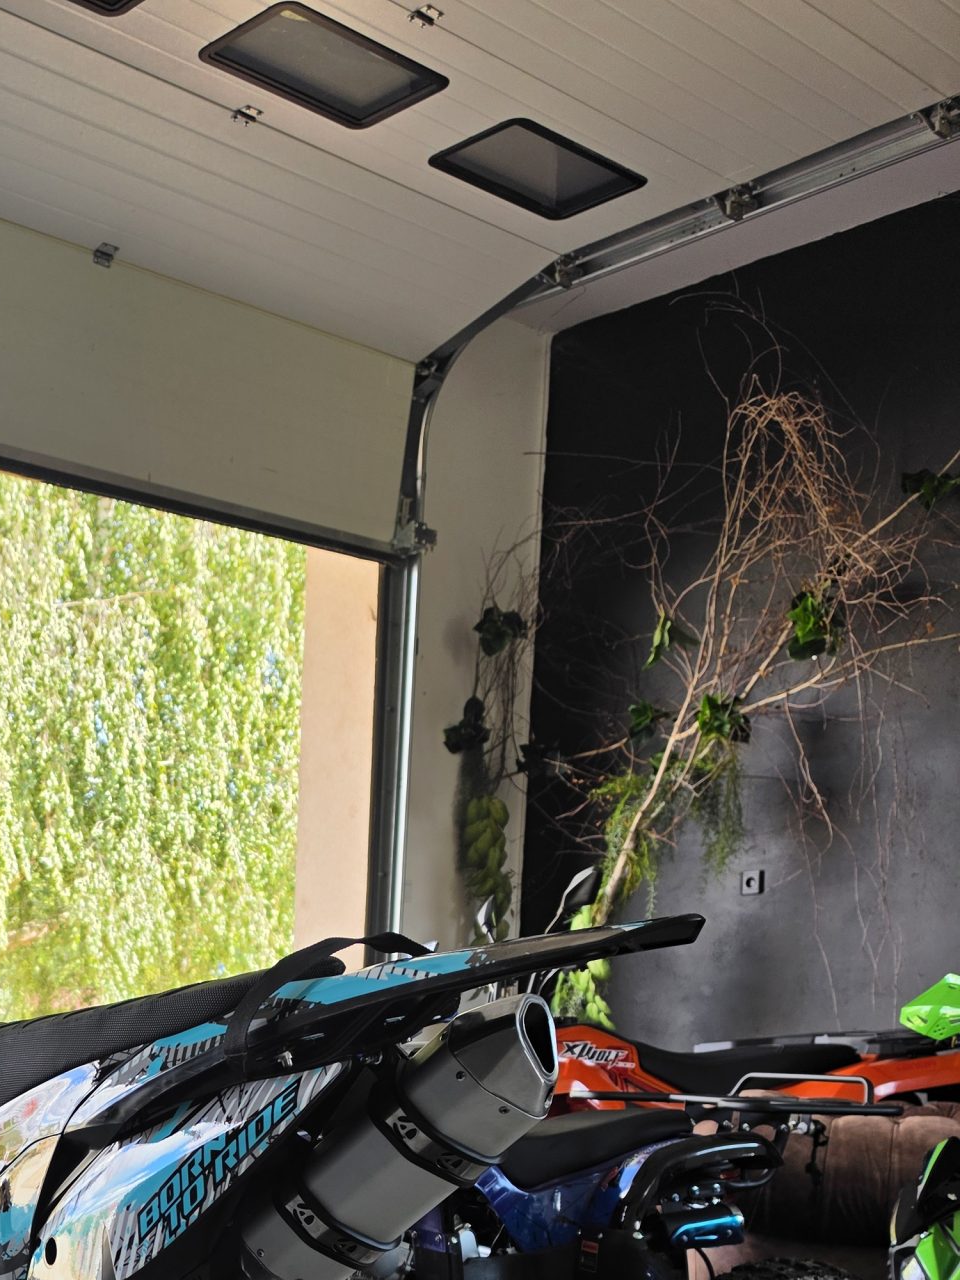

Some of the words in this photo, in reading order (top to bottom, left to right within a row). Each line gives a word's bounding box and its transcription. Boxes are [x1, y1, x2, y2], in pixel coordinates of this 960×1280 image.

[140, 1132, 227, 1237] BORN
[165, 1173, 205, 1231] TO
[214, 1082, 298, 1184] RIDE
